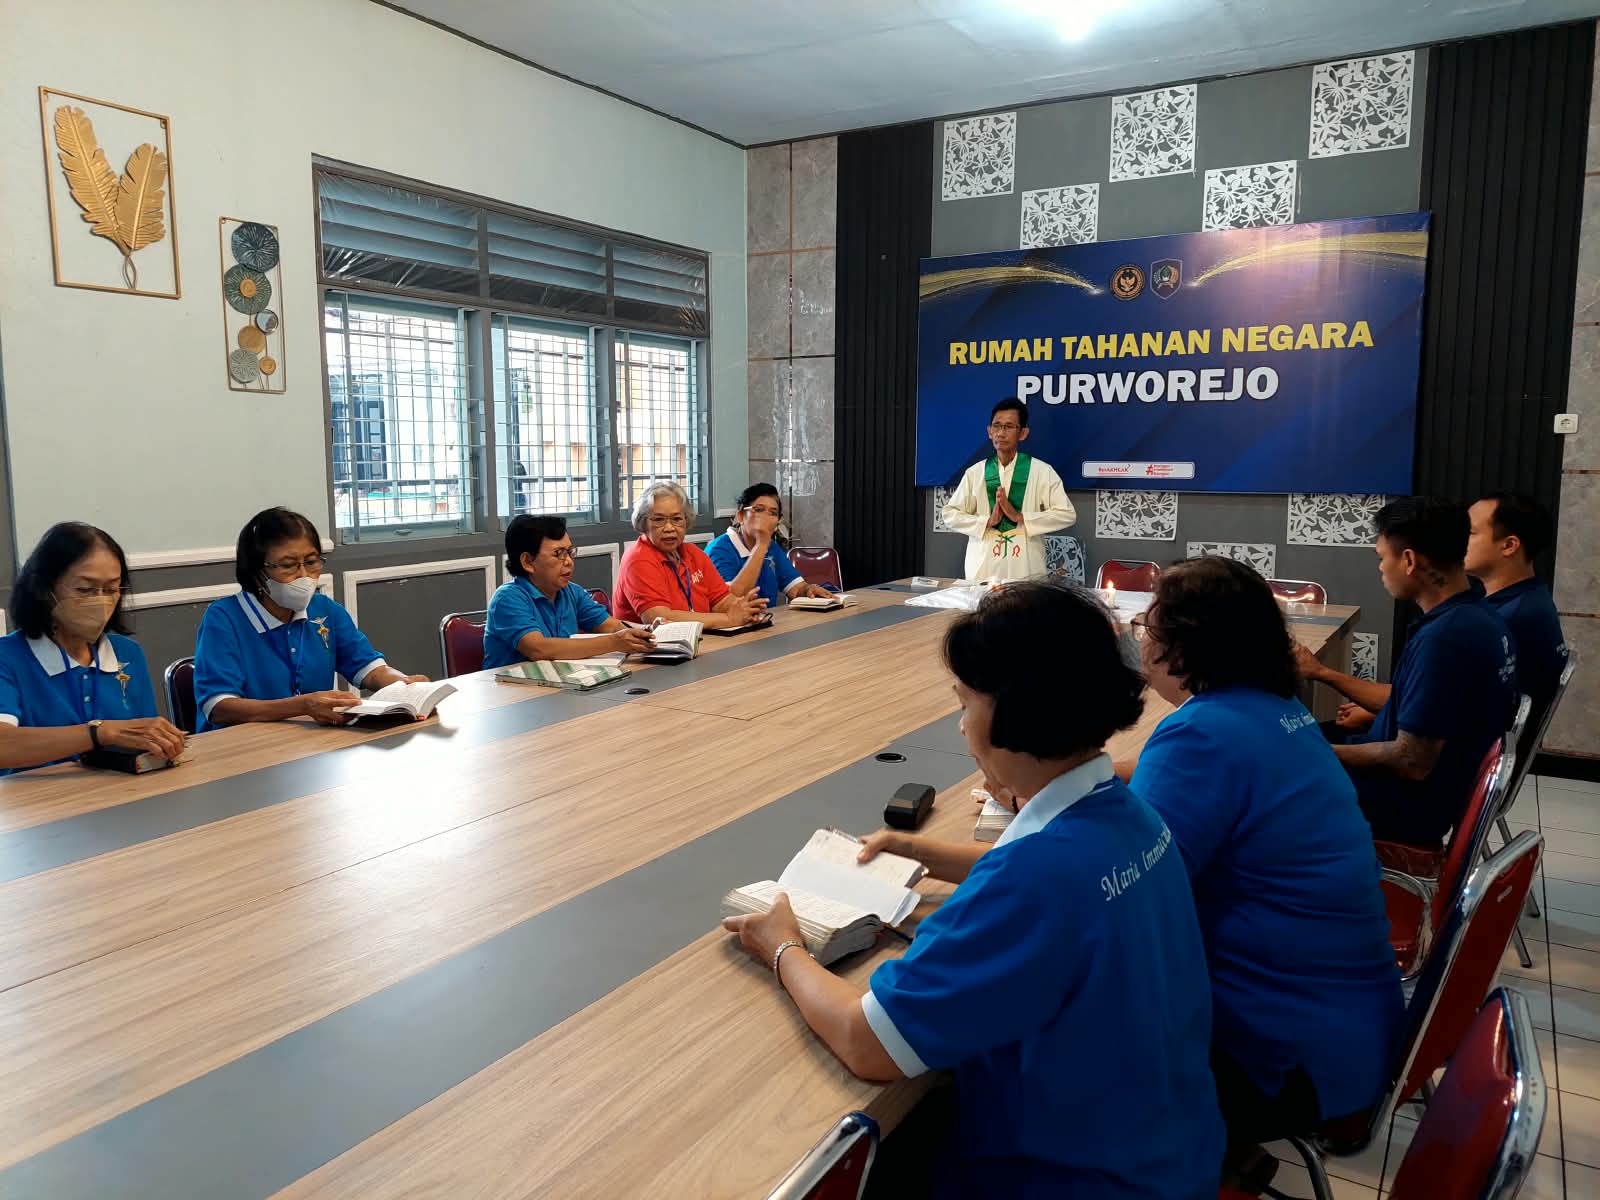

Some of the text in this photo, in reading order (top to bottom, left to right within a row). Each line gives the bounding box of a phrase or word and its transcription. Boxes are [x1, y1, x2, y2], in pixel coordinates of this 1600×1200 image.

[949, 320, 1374, 365] RUMAH TAHANAN NEGARA
[1016, 366, 1280, 405] PURWOREJO
[1100, 860, 1141, 902] Maria
